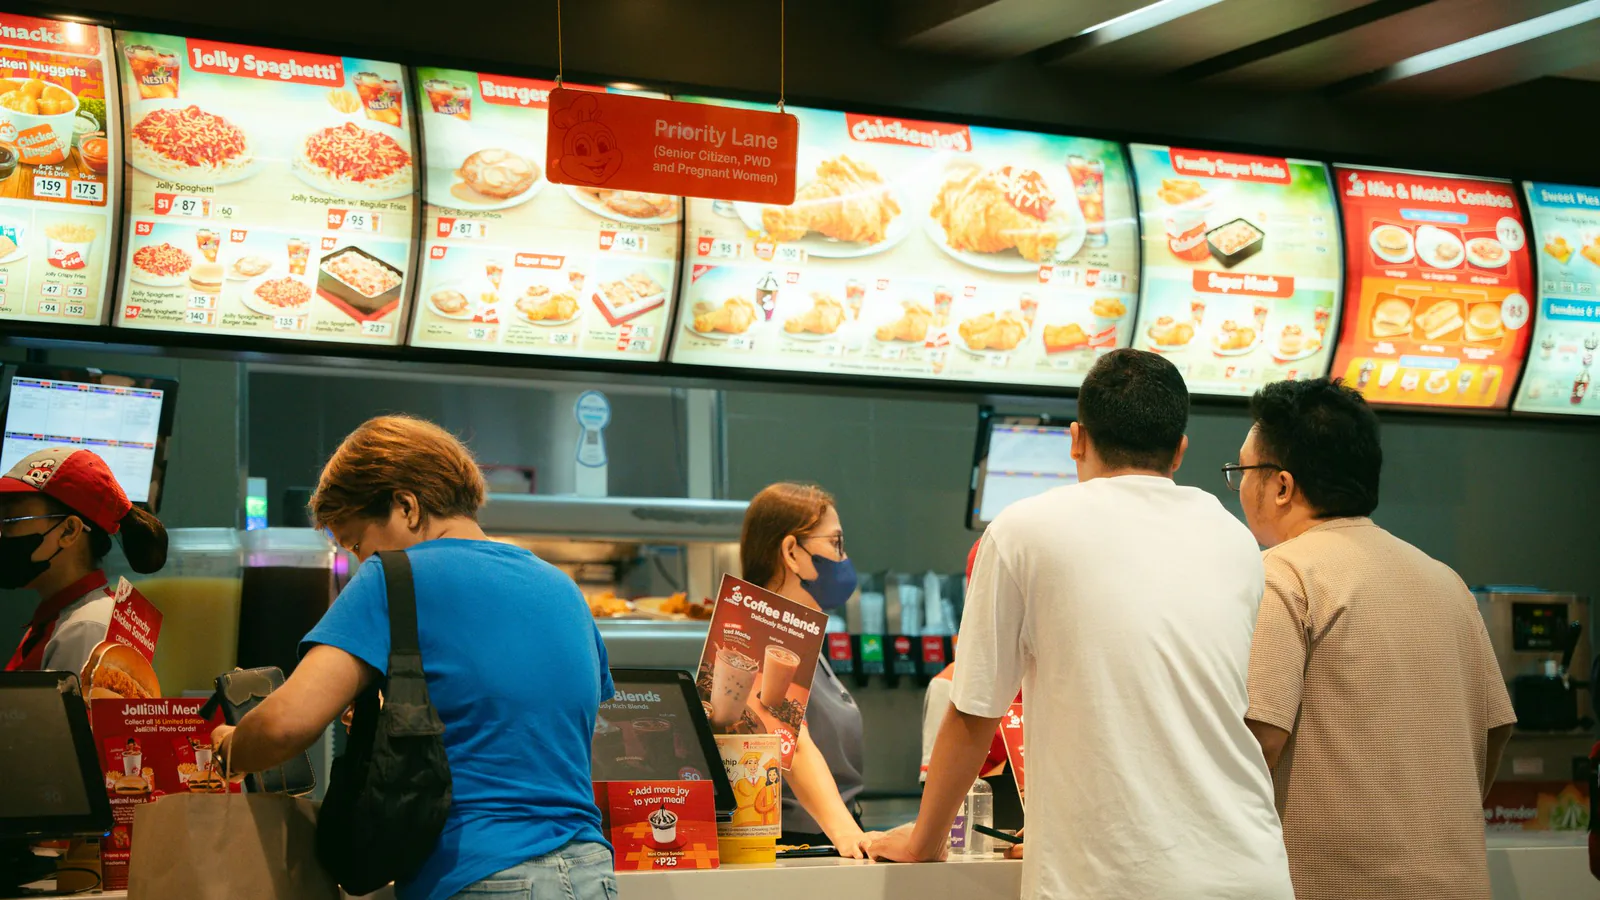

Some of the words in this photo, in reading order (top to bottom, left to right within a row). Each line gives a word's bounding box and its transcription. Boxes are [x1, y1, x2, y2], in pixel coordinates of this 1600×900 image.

[0, 22, 64, 44] nacks
[193, 48, 239, 72] Jolly
[29, 61, 87, 77] Nuggets
[655, 119, 726, 148] Priority
[731, 127, 778, 149] Lane
[653, 145, 696, 160] (Senior
[698, 149, 741, 167] Citizen,
[743, 154, 771, 168] PWD
[653, 161, 675, 173] and
[677, 164, 730, 182] Pregnant
[733, 169, 778, 185] Women)
[1175, 156, 1215, 175] Family
[1217, 159, 1250, 177] Super
[1252, 162, 1286, 178] Meals
[156, 181, 174, 192] Jolly
[175, 183, 214, 194] Spaghetti
[1367, 180, 1395, 198] Mix
[1396, 183, 1409, 199] &
[1411, 184, 1456, 203] Match
[1457, 188, 1513, 208] Combos
[157, 199, 169, 209] S1
[290, 193, 308, 203] Jolly
[310, 195, 346, 206] Spaghetti
[360, 200, 387, 210] Regular
[390, 202, 407, 211] Fries
[1541, 189, 1576, 204] Sweet
[182, 200, 196, 211] 87
[221, 207, 232, 216] 60
[351, 215, 364, 226] 95
[459, 223, 472, 234] 87
[46, 286, 58, 294] 47
[1208, 273, 1242, 292] Super
[1244, 275, 1278, 292] Meals
[72, 288, 83, 296] 75
[45, 304, 56, 313] 94
[69, 306, 83, 315] 152
[743, 595, 781, 620] Coffee
[782, 611, 821, 636] Blends
[113, 608, 132, 632] Chicken
[131, 625, 155, 653] Sandwich
[131, 610, 151, 637] Crunchy
[750, 612, 777, 629] Deliciously
[776, 623, 788, 633] Rich
[788, 627, 805, 640] Blends
[734, 630, 752, 641] Mocha
[613, 690, 662, 703] Blends
[676, 786, 690, 796] joy
[633, 798, 643, 806] to
[643, 797, 661, 806] your
[663, 796, 686, 805] meal!
